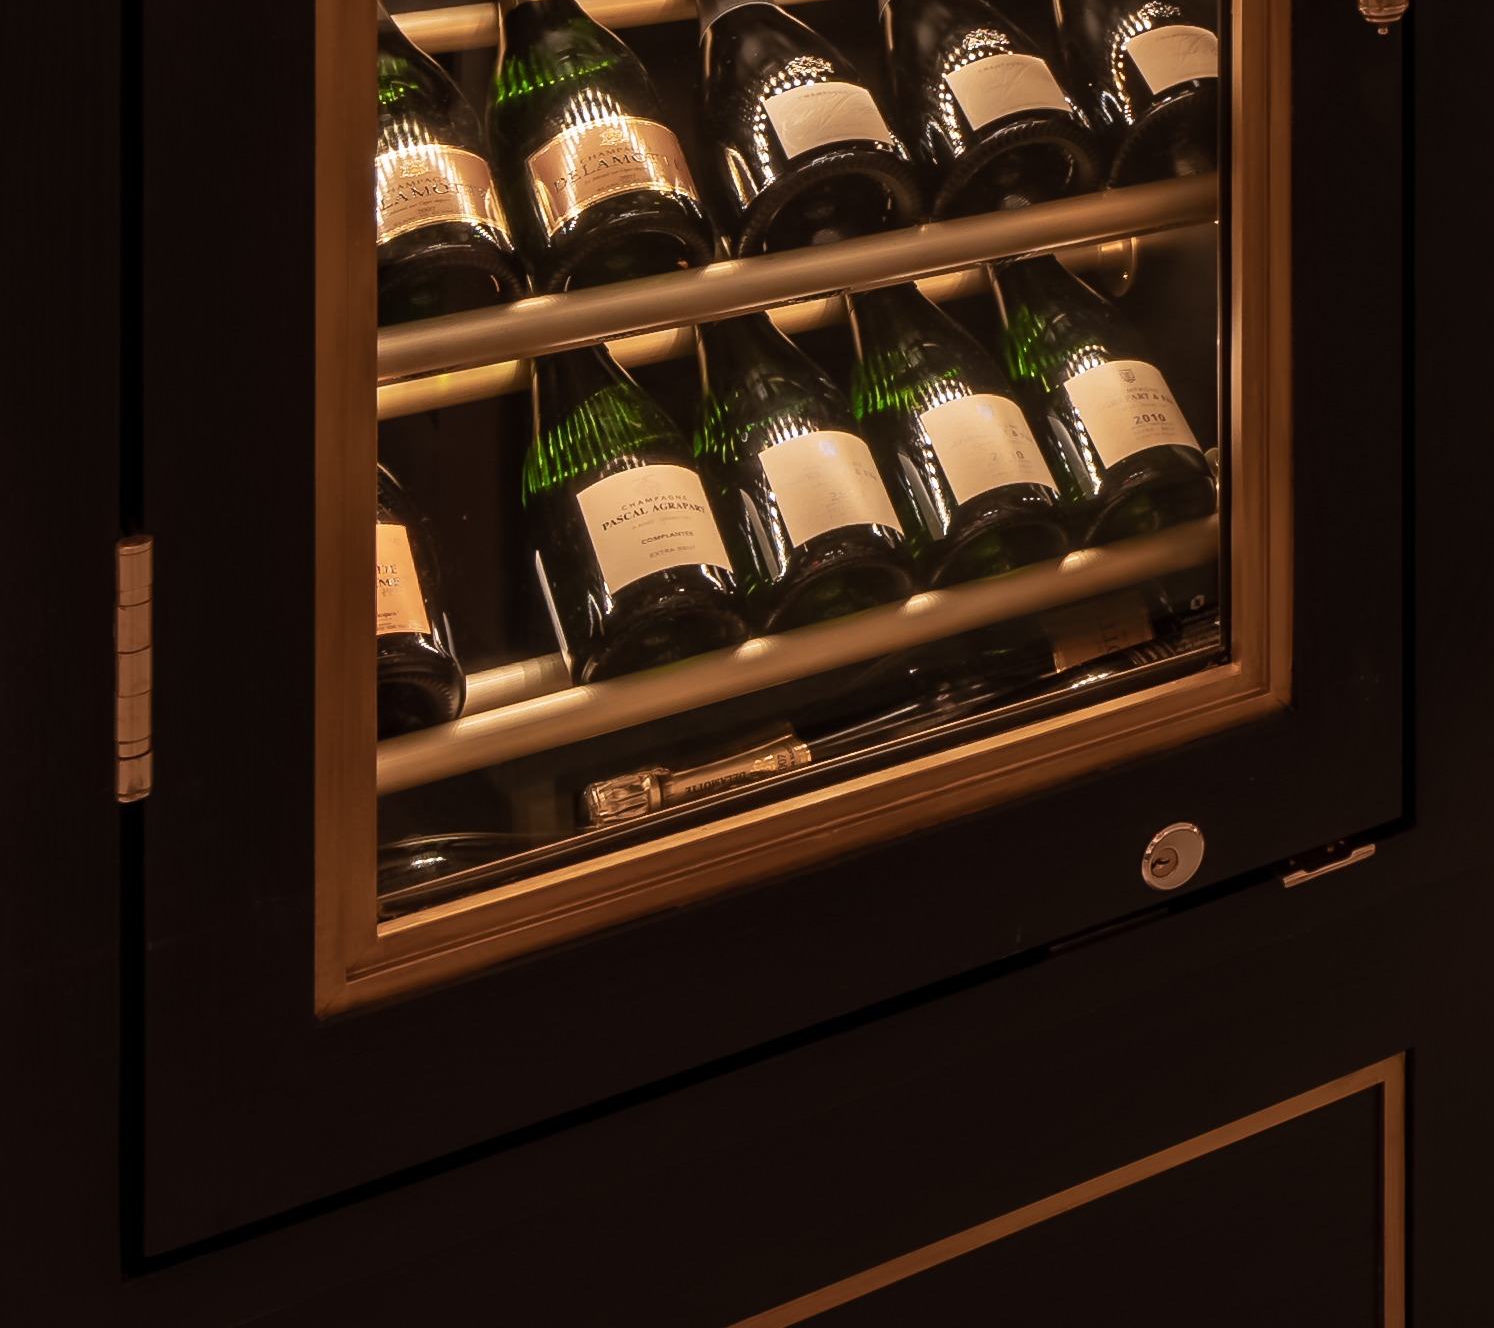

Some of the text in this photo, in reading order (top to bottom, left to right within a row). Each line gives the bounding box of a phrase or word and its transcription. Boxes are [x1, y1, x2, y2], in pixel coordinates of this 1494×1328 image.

[1133, 413, 1168, 425] 2010
[621, 494, 688, 511] CHAMPAGNE
[601, 507, 649, 532] PASCAL
[652, 501, 706, 515] AGRAPART
[649, 547, 676, 558] EXTRA
[685, 770, 747, 795] DELAMOTTE
